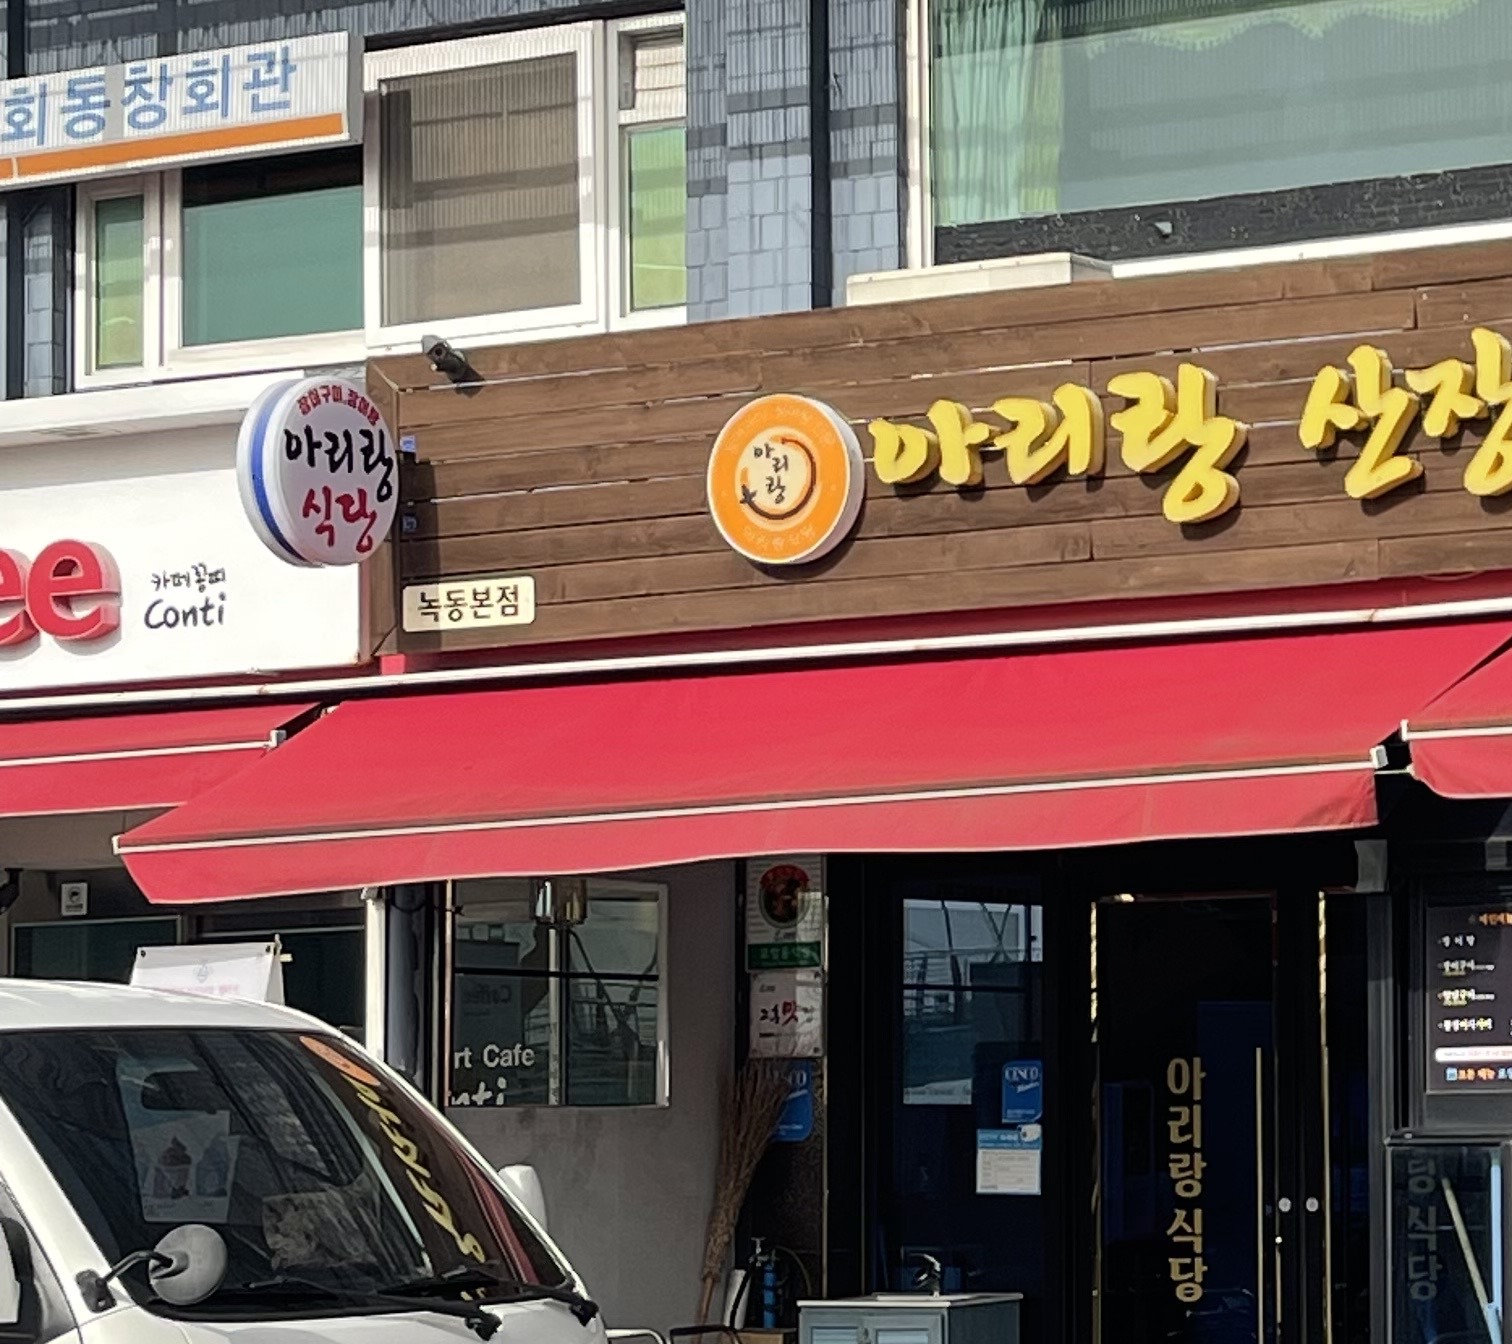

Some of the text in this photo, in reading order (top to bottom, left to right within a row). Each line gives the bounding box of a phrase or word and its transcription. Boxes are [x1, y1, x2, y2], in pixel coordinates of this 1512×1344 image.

[284, 425, 394, 502] 아리랑
[753, 443, 790, 503] 아리랑
[869, 362, 1248, 523] 아리랑
[302, 485, 378, 553] 식당
[144, 592, 226, 629] Conti
[417, 585, 521, 622] 녹동본점
[483, 1043, 535, 1068] Cafe
[1166, 1057, 1208, 1302] 아리랑 식당
